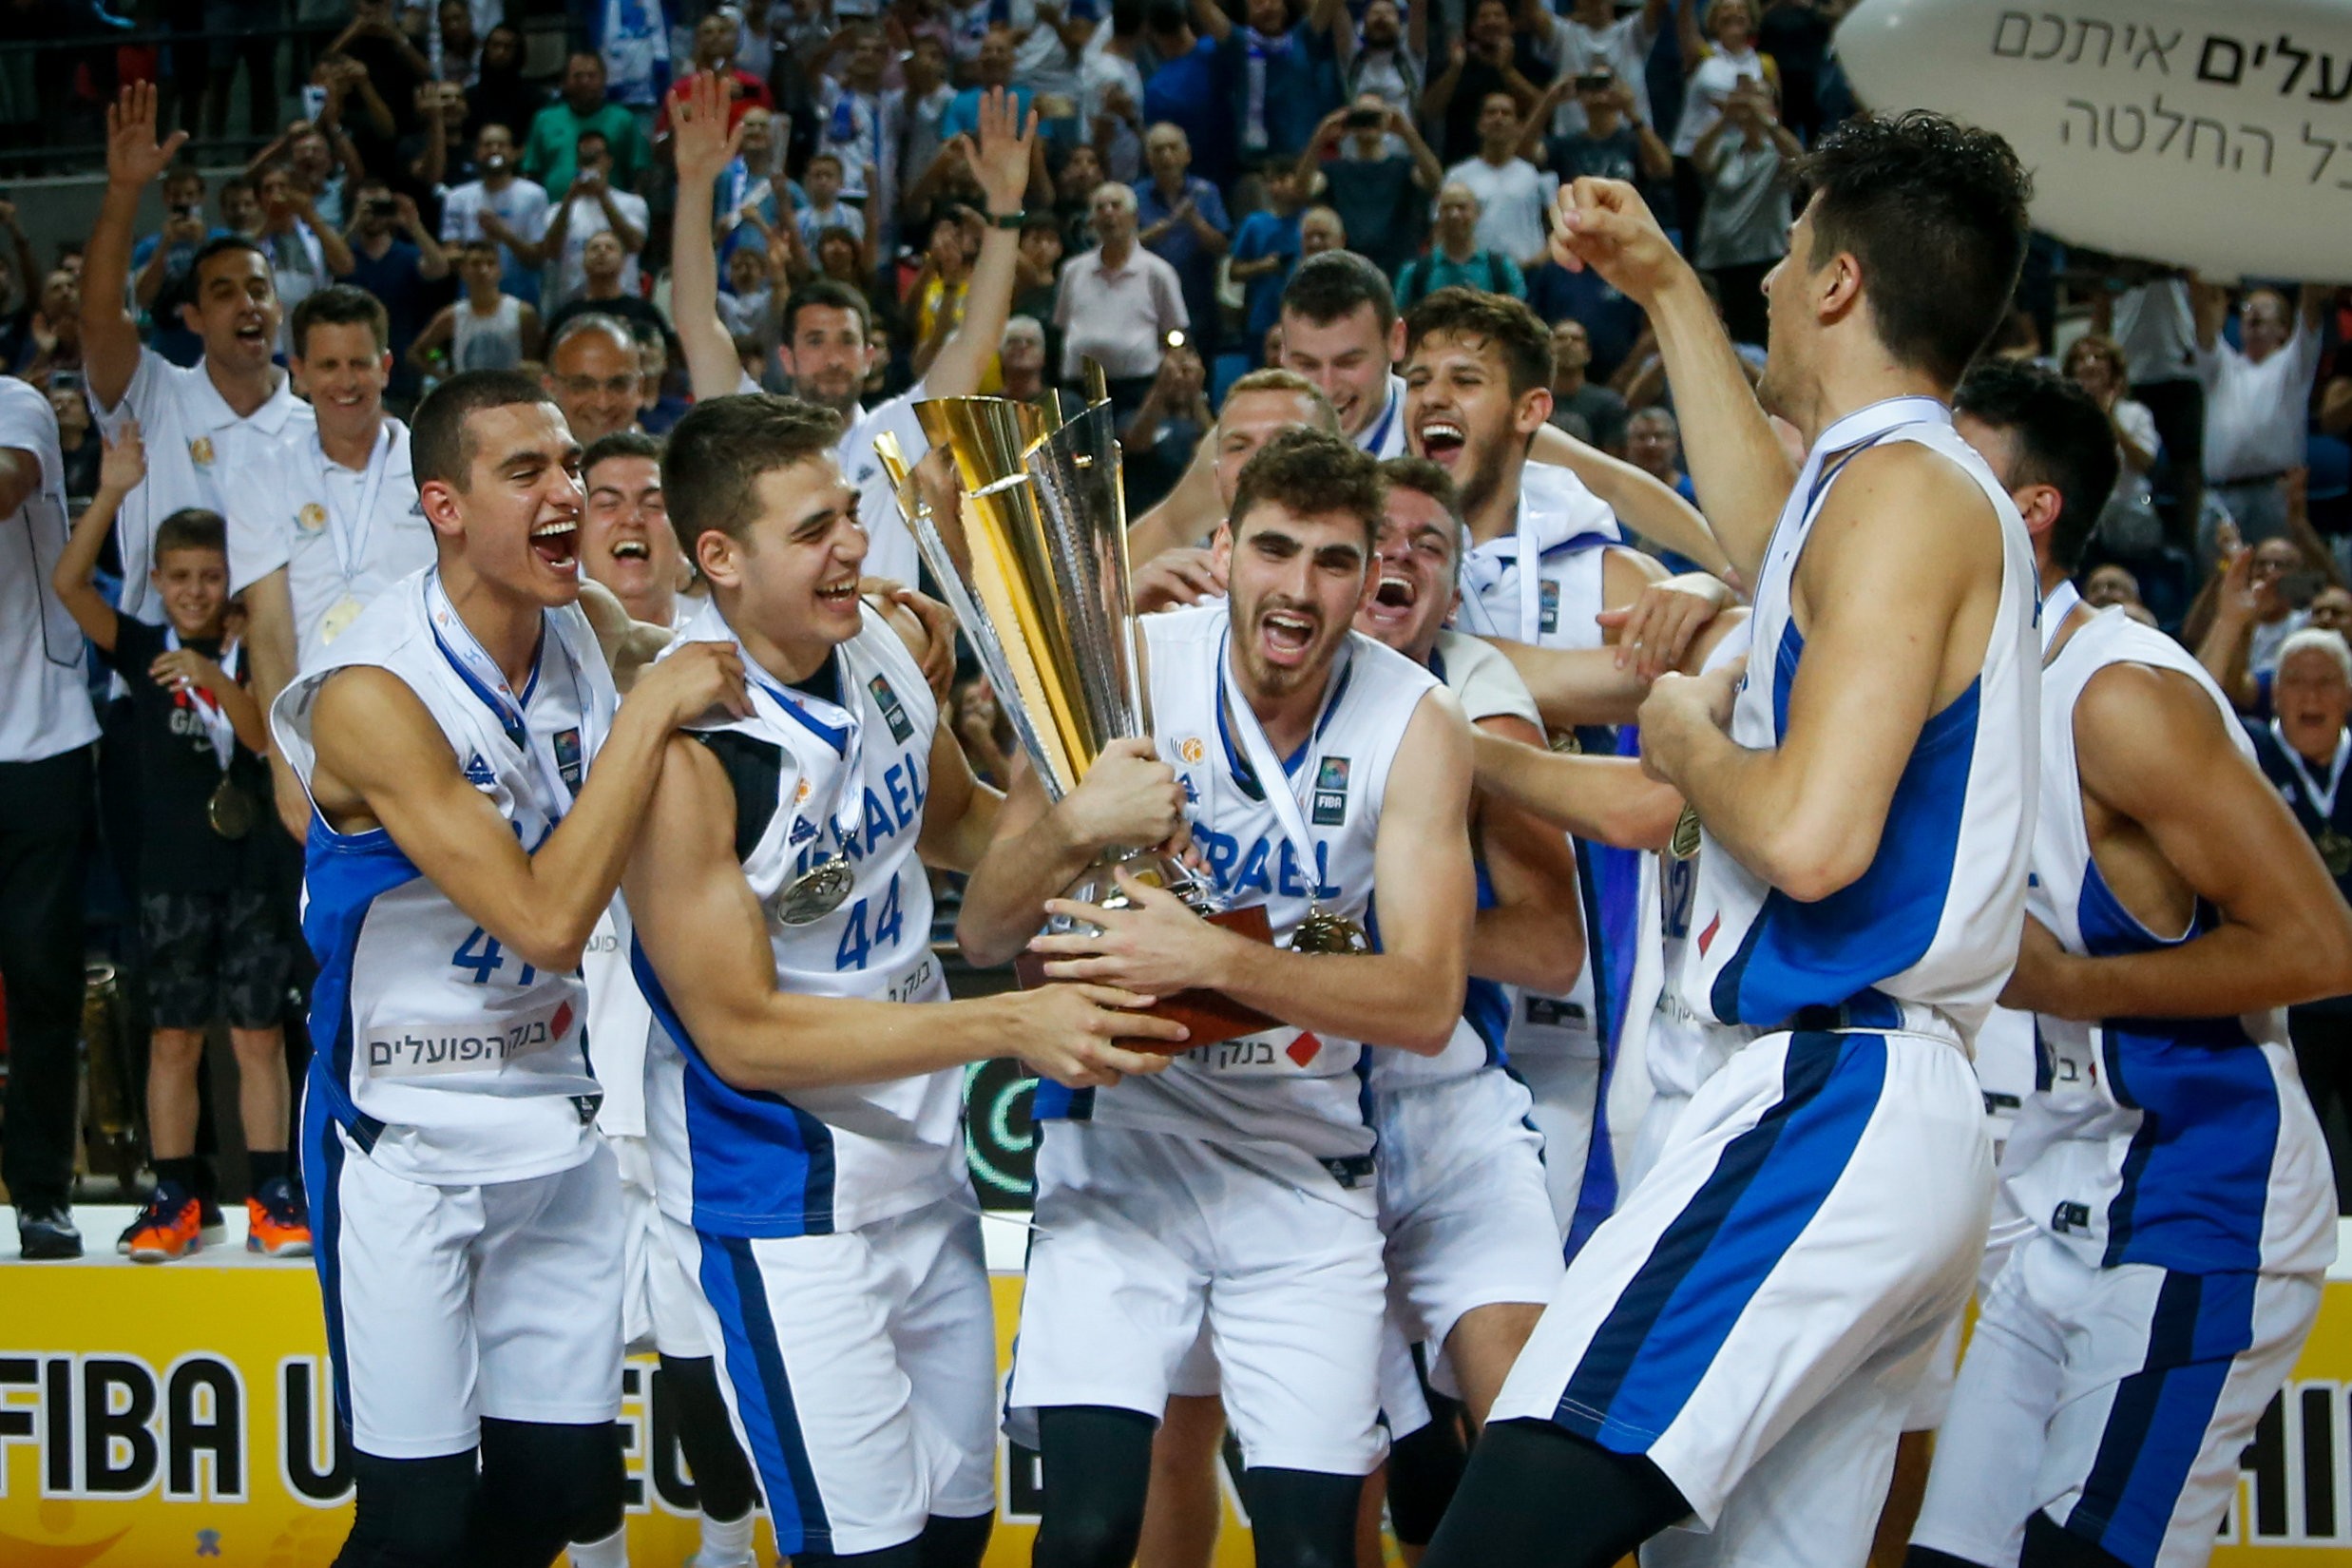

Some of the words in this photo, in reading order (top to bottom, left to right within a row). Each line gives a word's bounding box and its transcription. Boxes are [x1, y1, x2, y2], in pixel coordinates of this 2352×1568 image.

[1992, 11, 2183, 75] איתכם
[2060, 96, 2274, 176] החלטה
[1318, 795, 1343, 810] FIBA
[836, 871, 904, 970] 44
[370, 1035, 505, 1066] הפועלים
[1220, 1041, 1275, 1070] בנק
